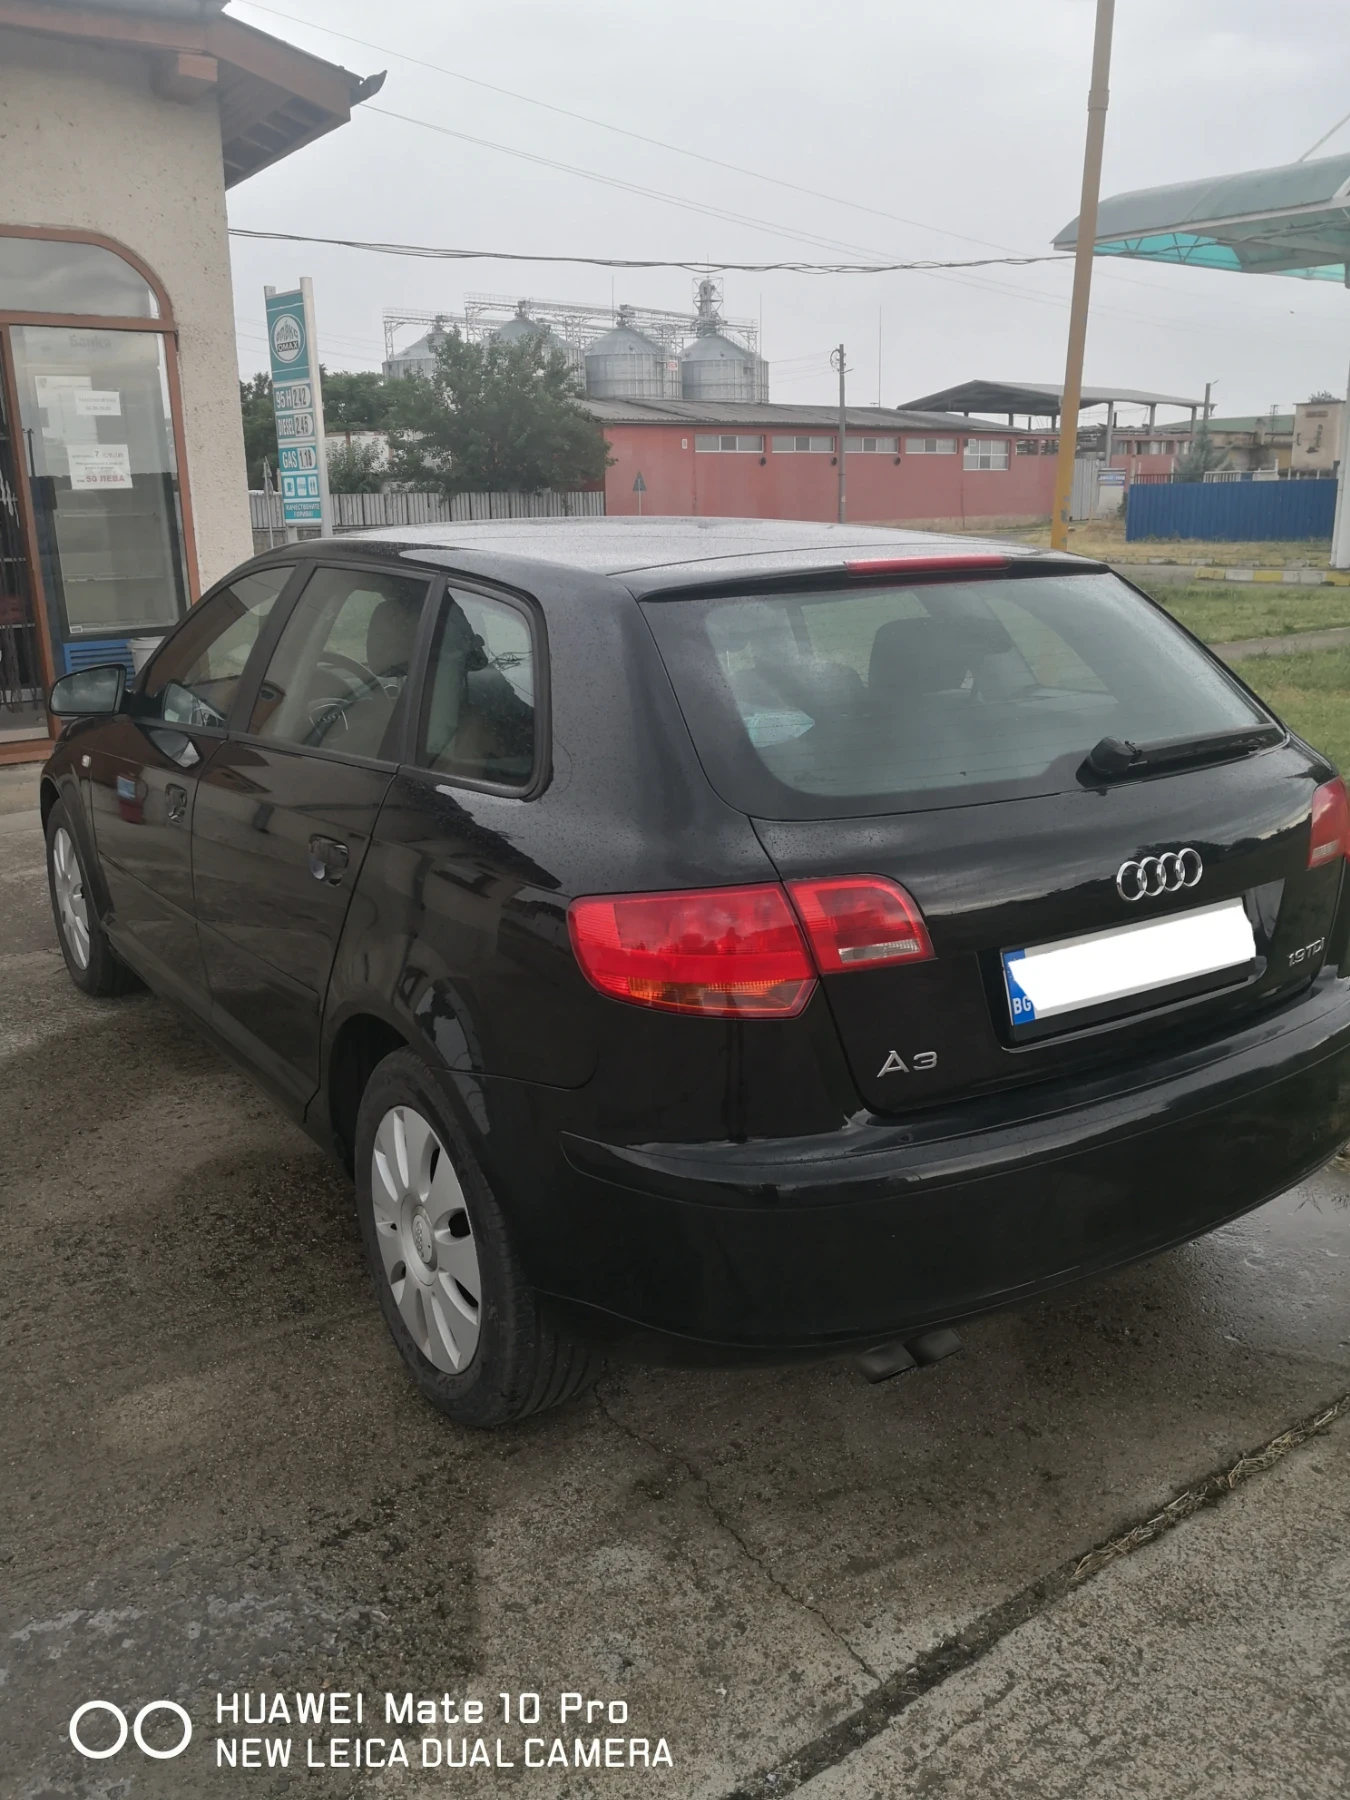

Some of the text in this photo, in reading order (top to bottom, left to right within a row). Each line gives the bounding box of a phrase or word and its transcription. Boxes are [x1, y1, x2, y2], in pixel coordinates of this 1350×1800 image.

[278, 341, 298, 351] OMAX
[275, 390, 286, 409] 95
[277, 417, 295, 436] DIESEL
[282, 450, 298, 469] GAS
[86, 475, 98, 483] 50
[1012, 995, 1032, 1015] BG
[876, 1050, 938, 1078] A3
